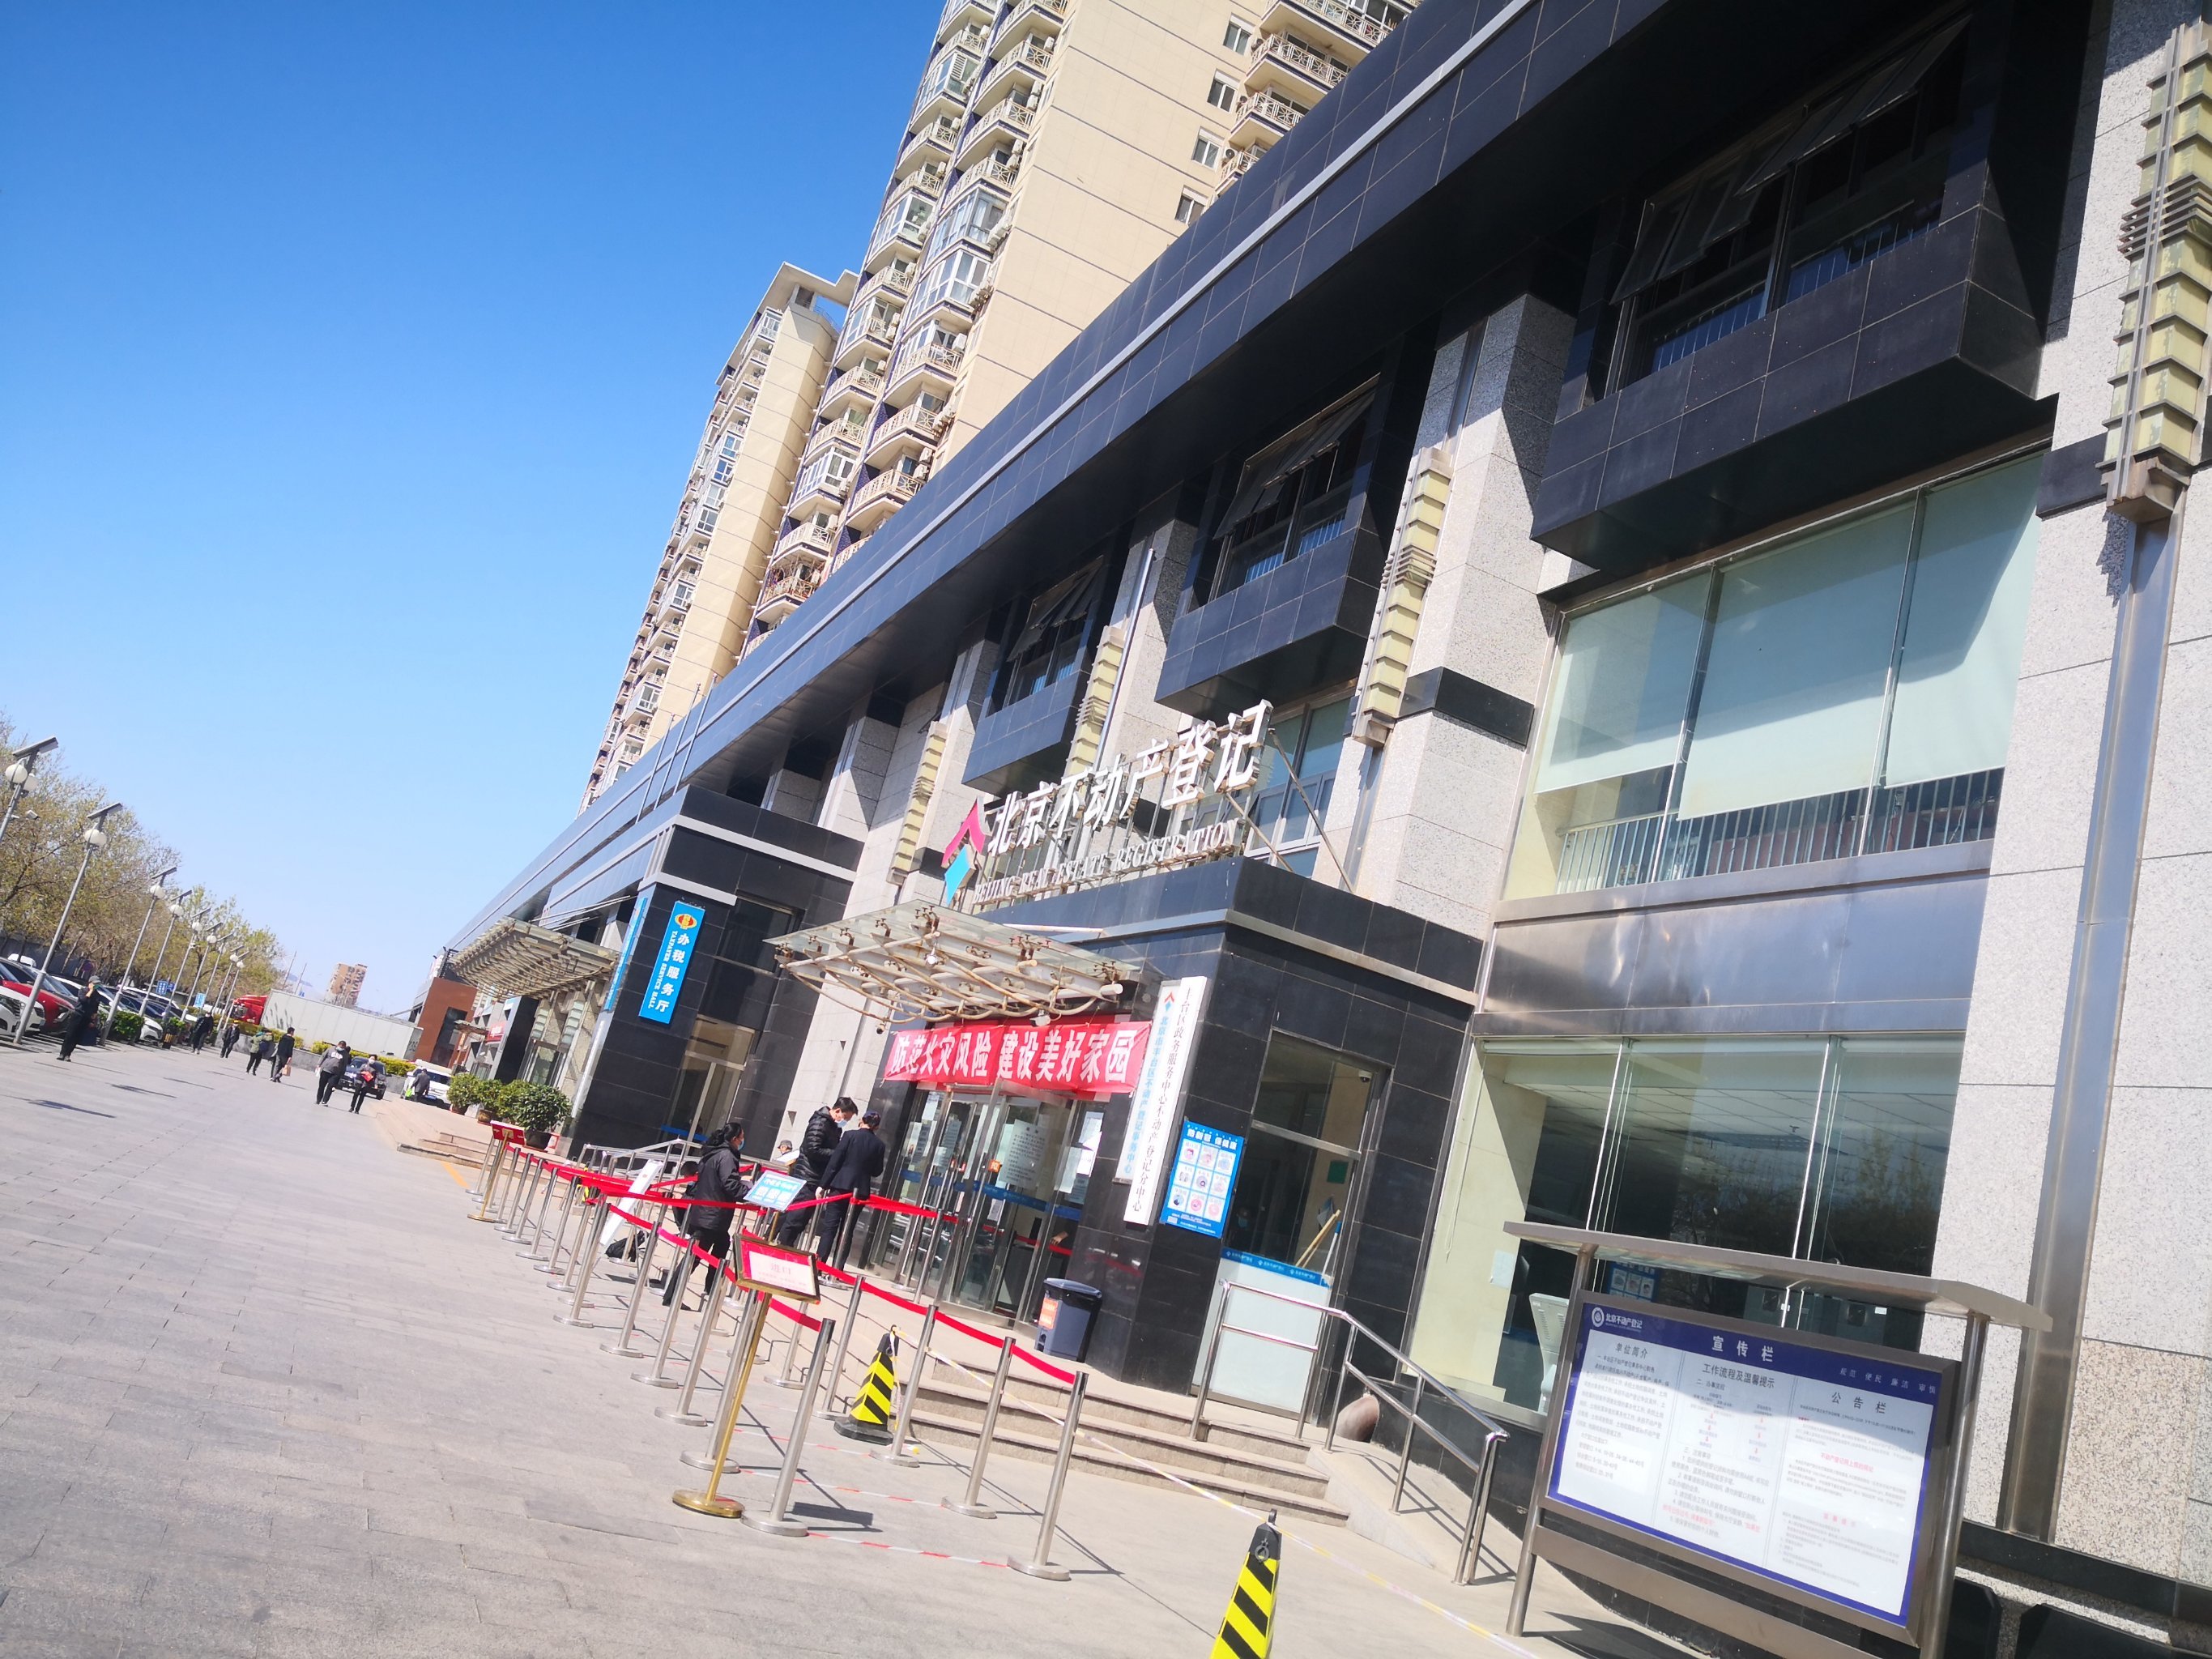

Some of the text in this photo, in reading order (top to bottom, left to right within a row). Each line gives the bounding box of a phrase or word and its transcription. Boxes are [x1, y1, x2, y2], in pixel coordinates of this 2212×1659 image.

[988, 699, 1272, 856] 北京不动产登记
[973, 818, 1239, 904] BEIJING REAL ESTATE REGISTRATION
[654, 963, 667, 990] SERVICE
[655, 933, 690, 1013] 办税服务厅
[648, 992, 658, 1009] HALL
[892, 1028, 1138, 1083] 防范火灾风险 建设美好家园
[1605, 1313, 1643, 1329] 北京不动产登记
[1615, 1343, 1648, 1359] 单位简介
[1711, 1335, 1774, 1362] 宣传栏
[1702, 1363, 1775, 1388] 工作流程及温馨提示
[1831, 1391, 1886, 1414] 公告栏
